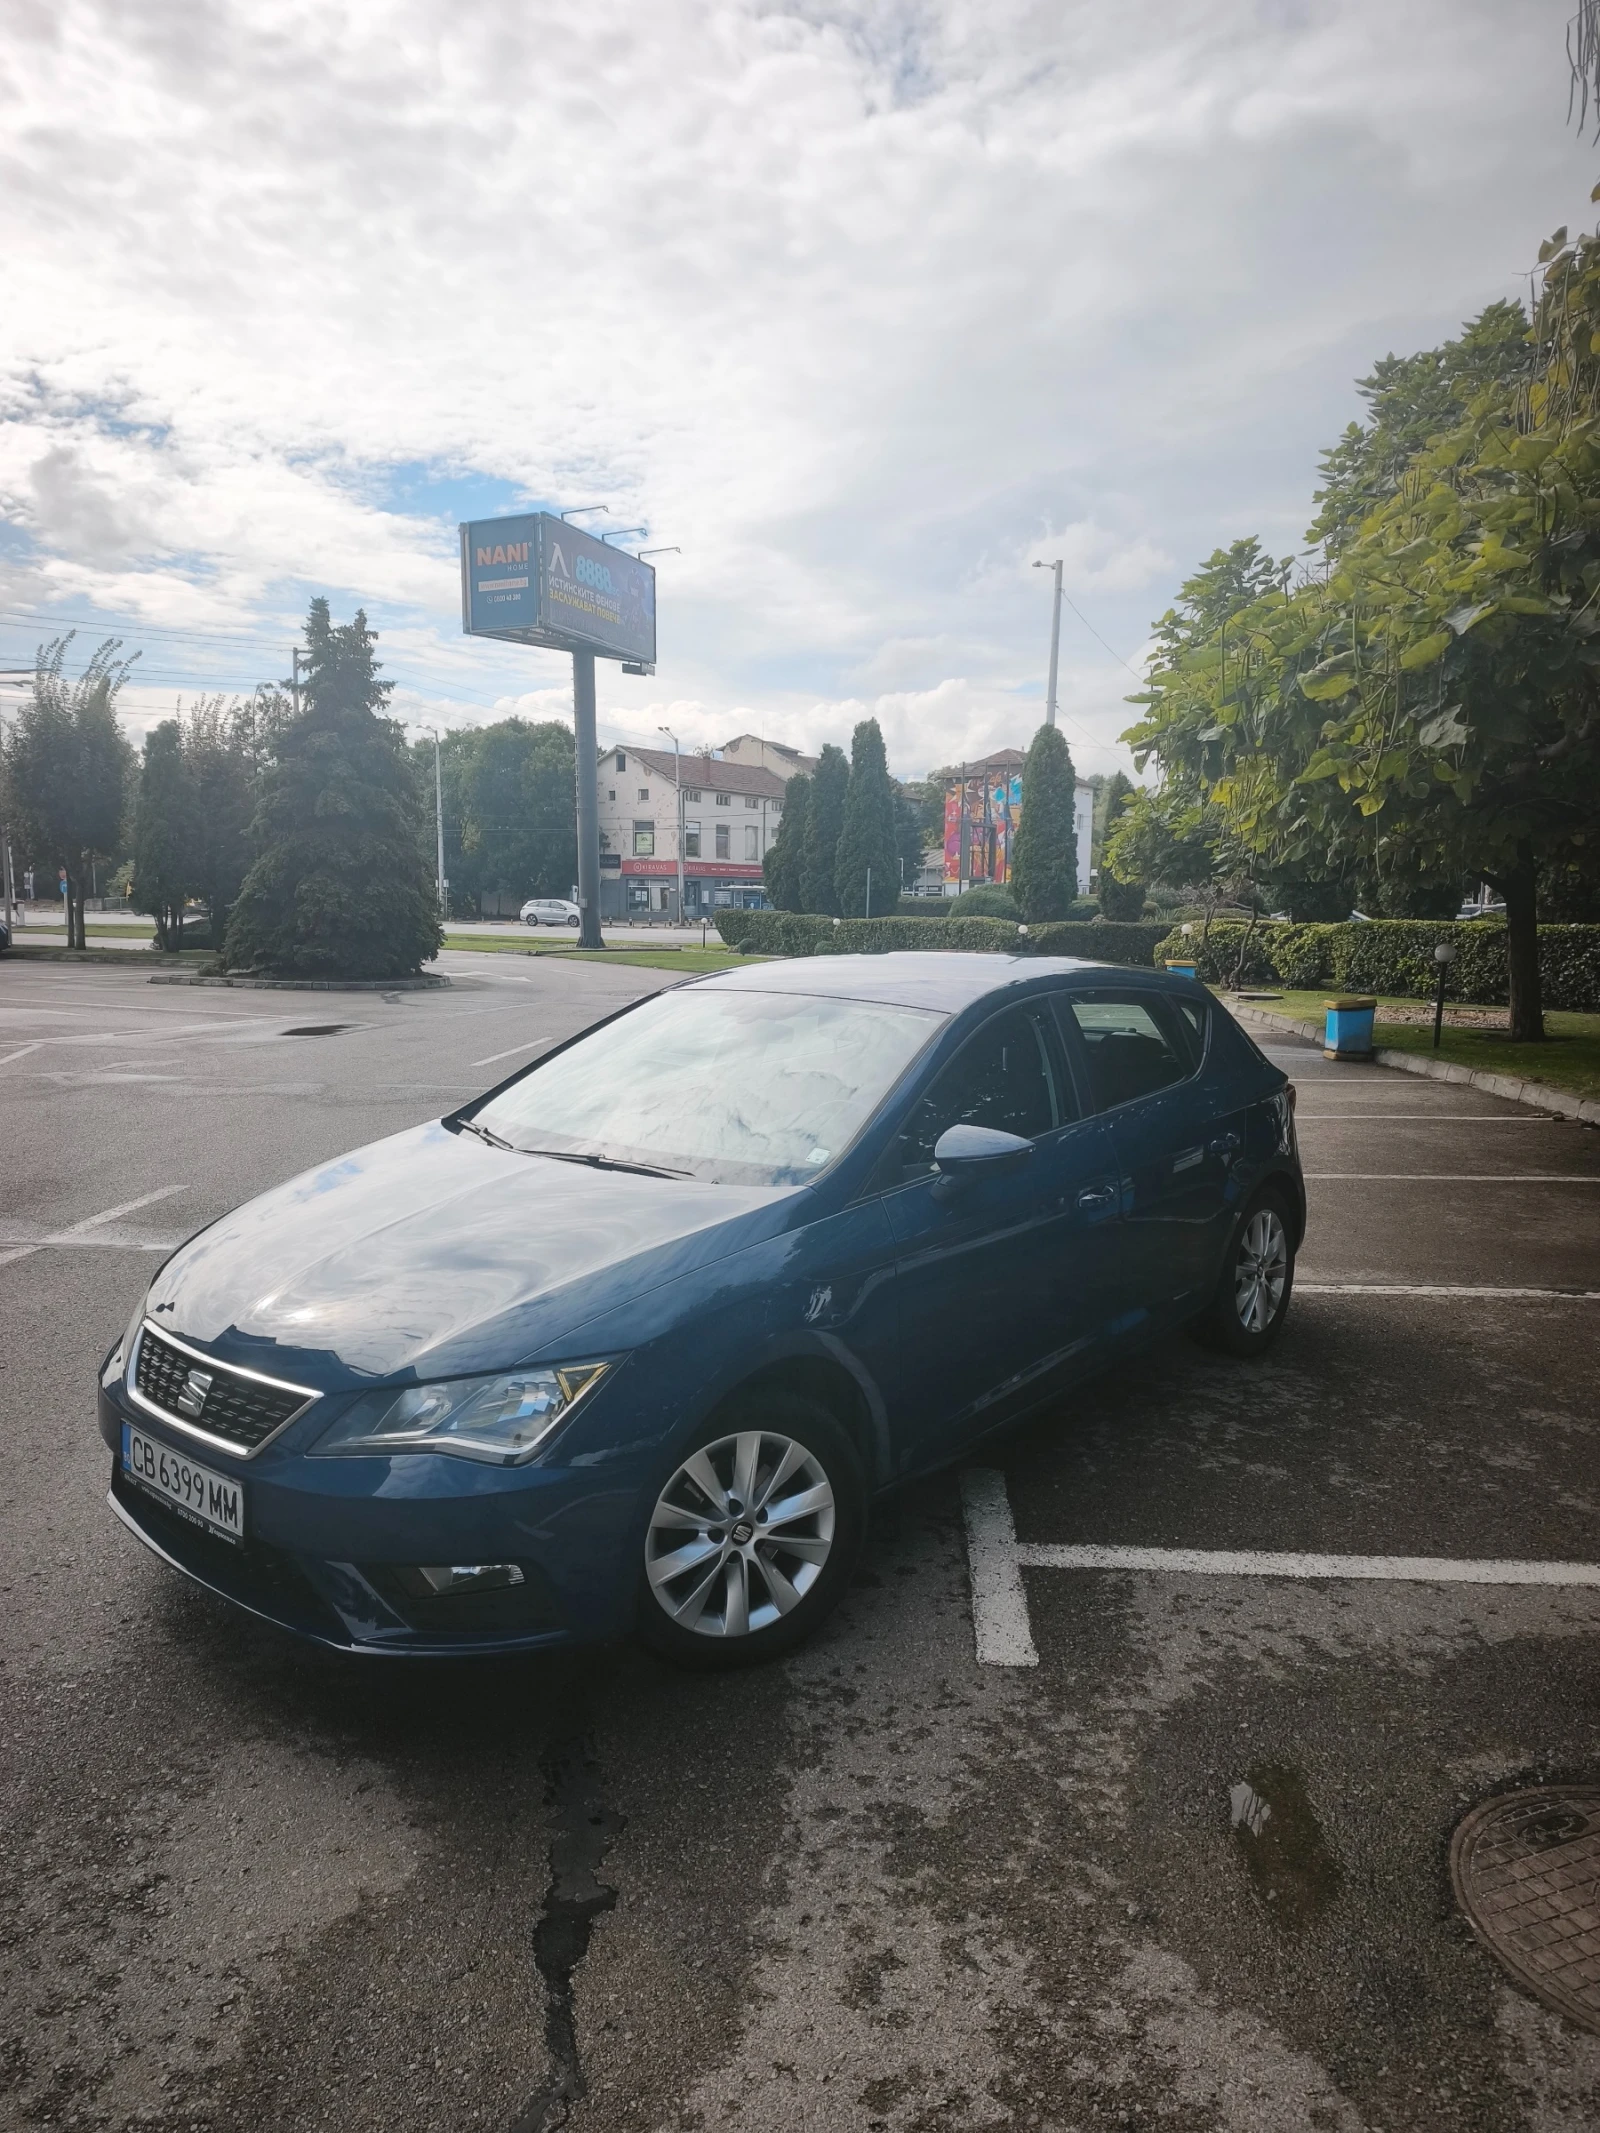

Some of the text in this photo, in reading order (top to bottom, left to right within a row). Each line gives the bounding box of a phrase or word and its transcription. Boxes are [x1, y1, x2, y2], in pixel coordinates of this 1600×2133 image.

[476, 542, 529, 567] NANI
[507, 562, 529, 572] HOME
[548, 574, 621, 613] ИСТИНСКИТЕ ФЕНОВЕ
[548, 587, 621, 624] ЗАСЛУЖАВАТ ПОВЕЧЕ
[122, 1450, 131, 1464] BG
[132, 1436, 156, 1480] CB
[159, 1452, 204, 1509] 6399
[208, 1478, 238, 1529] MM
